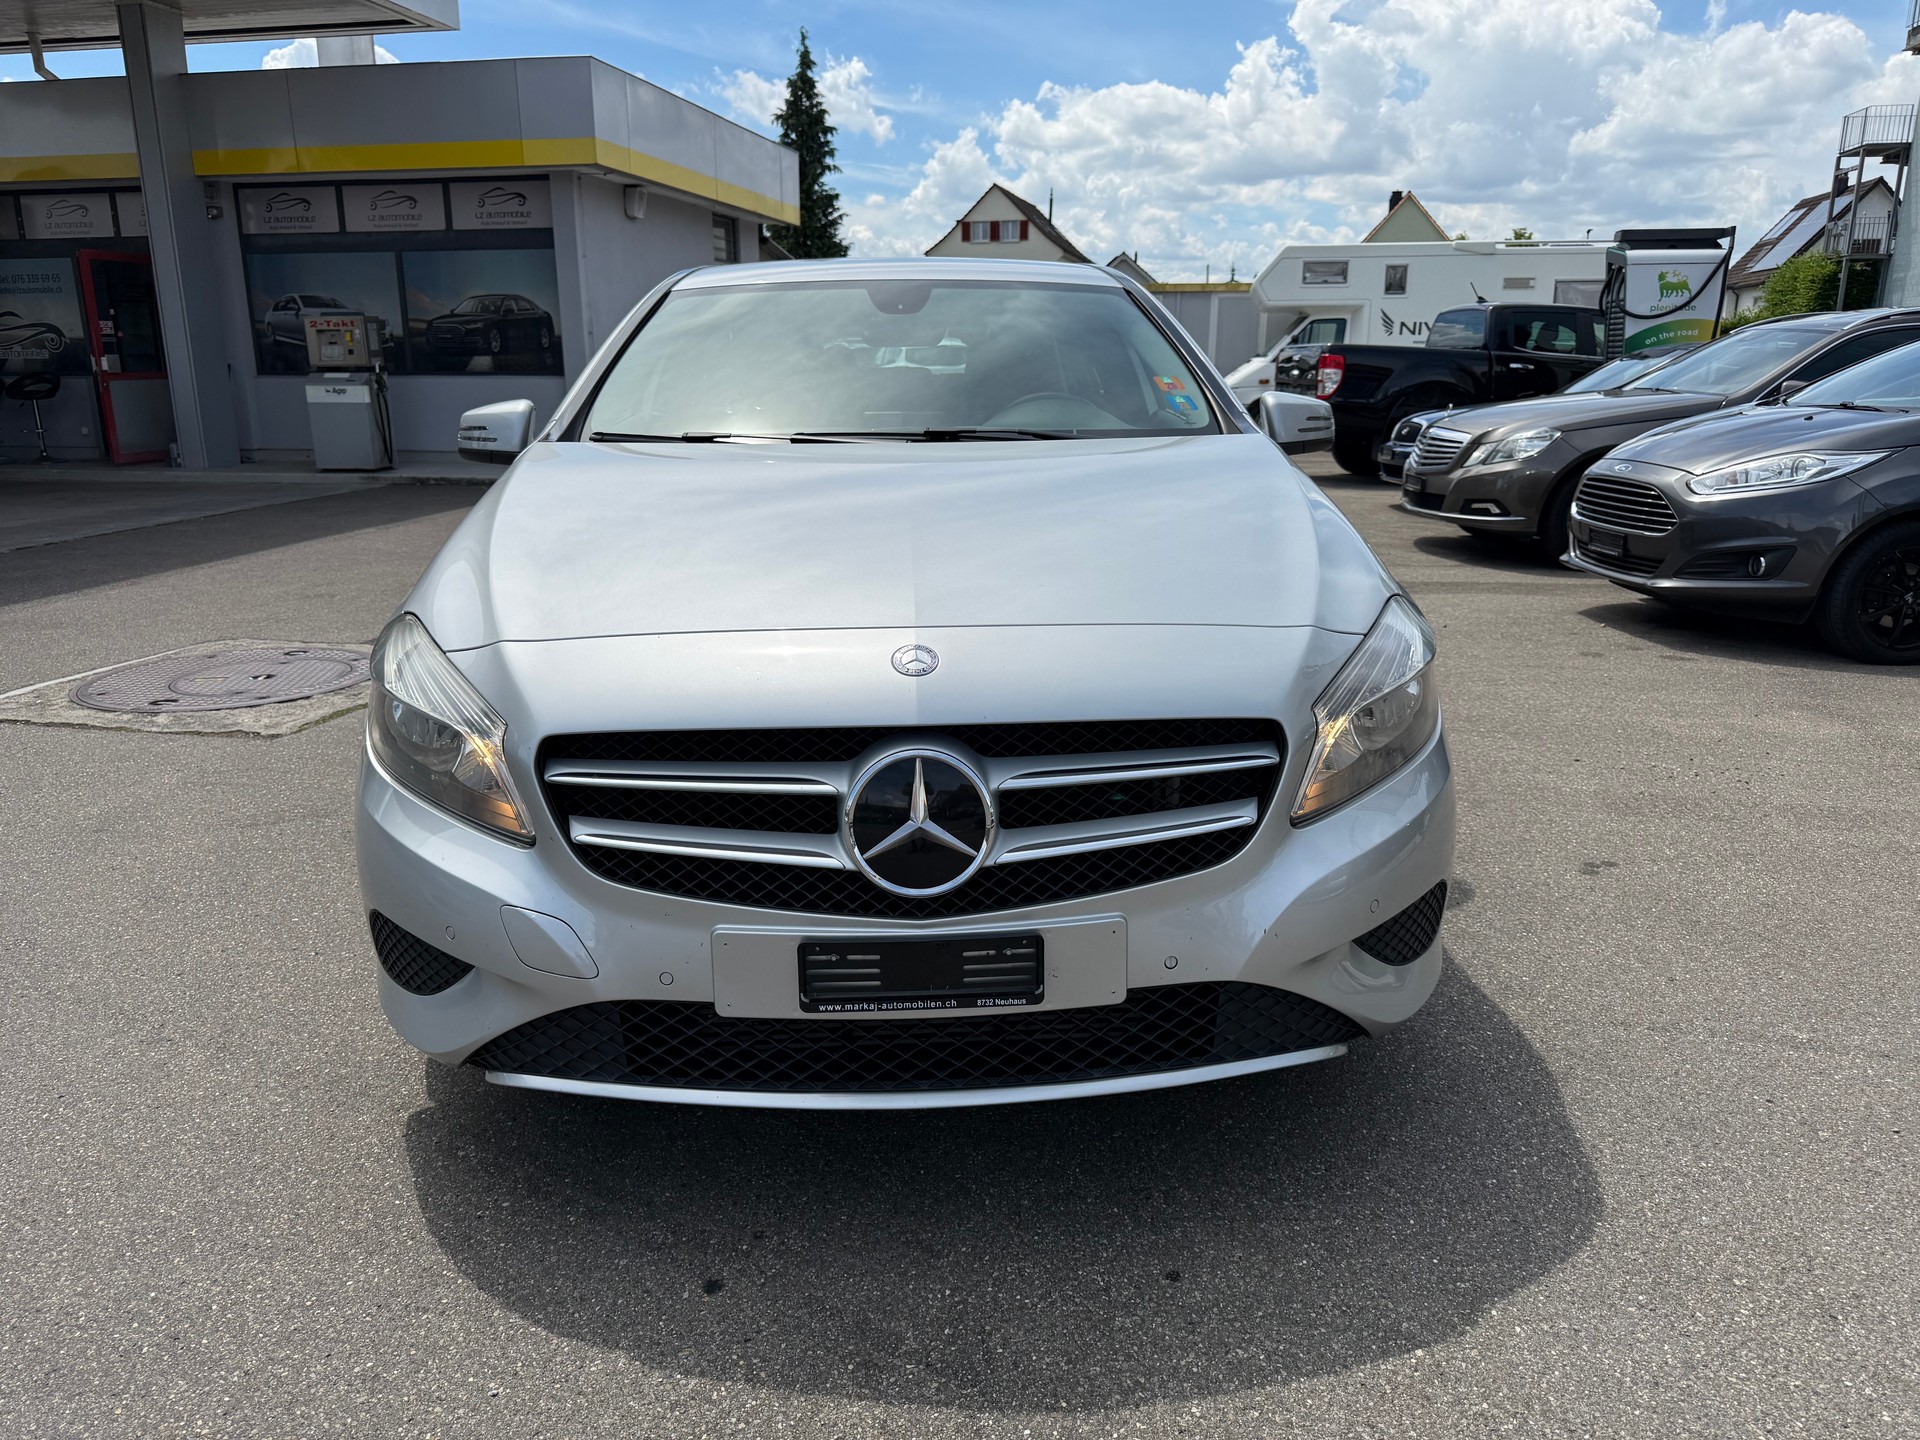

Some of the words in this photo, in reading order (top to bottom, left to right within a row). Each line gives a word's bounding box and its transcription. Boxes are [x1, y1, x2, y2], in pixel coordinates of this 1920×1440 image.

[273, 215, 317, 223] automobile
[377, 213, 423, 221] automobile
[485, 210, 532, 219] automobile
[11, 273, 26, 283] 076
[26, 273, 39, 283] 339
[41, 273, 50, 283] 69
[51, 273, 61, 283] 65
[309, 319, 356, 328] 2-Takt
[1645, 336, 1657, 344] on
[1659, 330, 1675, 340] the
[1677, 328, 1699, 337] road
[818, 999, 958, 1012] www.markaj-automobilen.ch
[995, 997, 1027, 1006] Neuhaus
